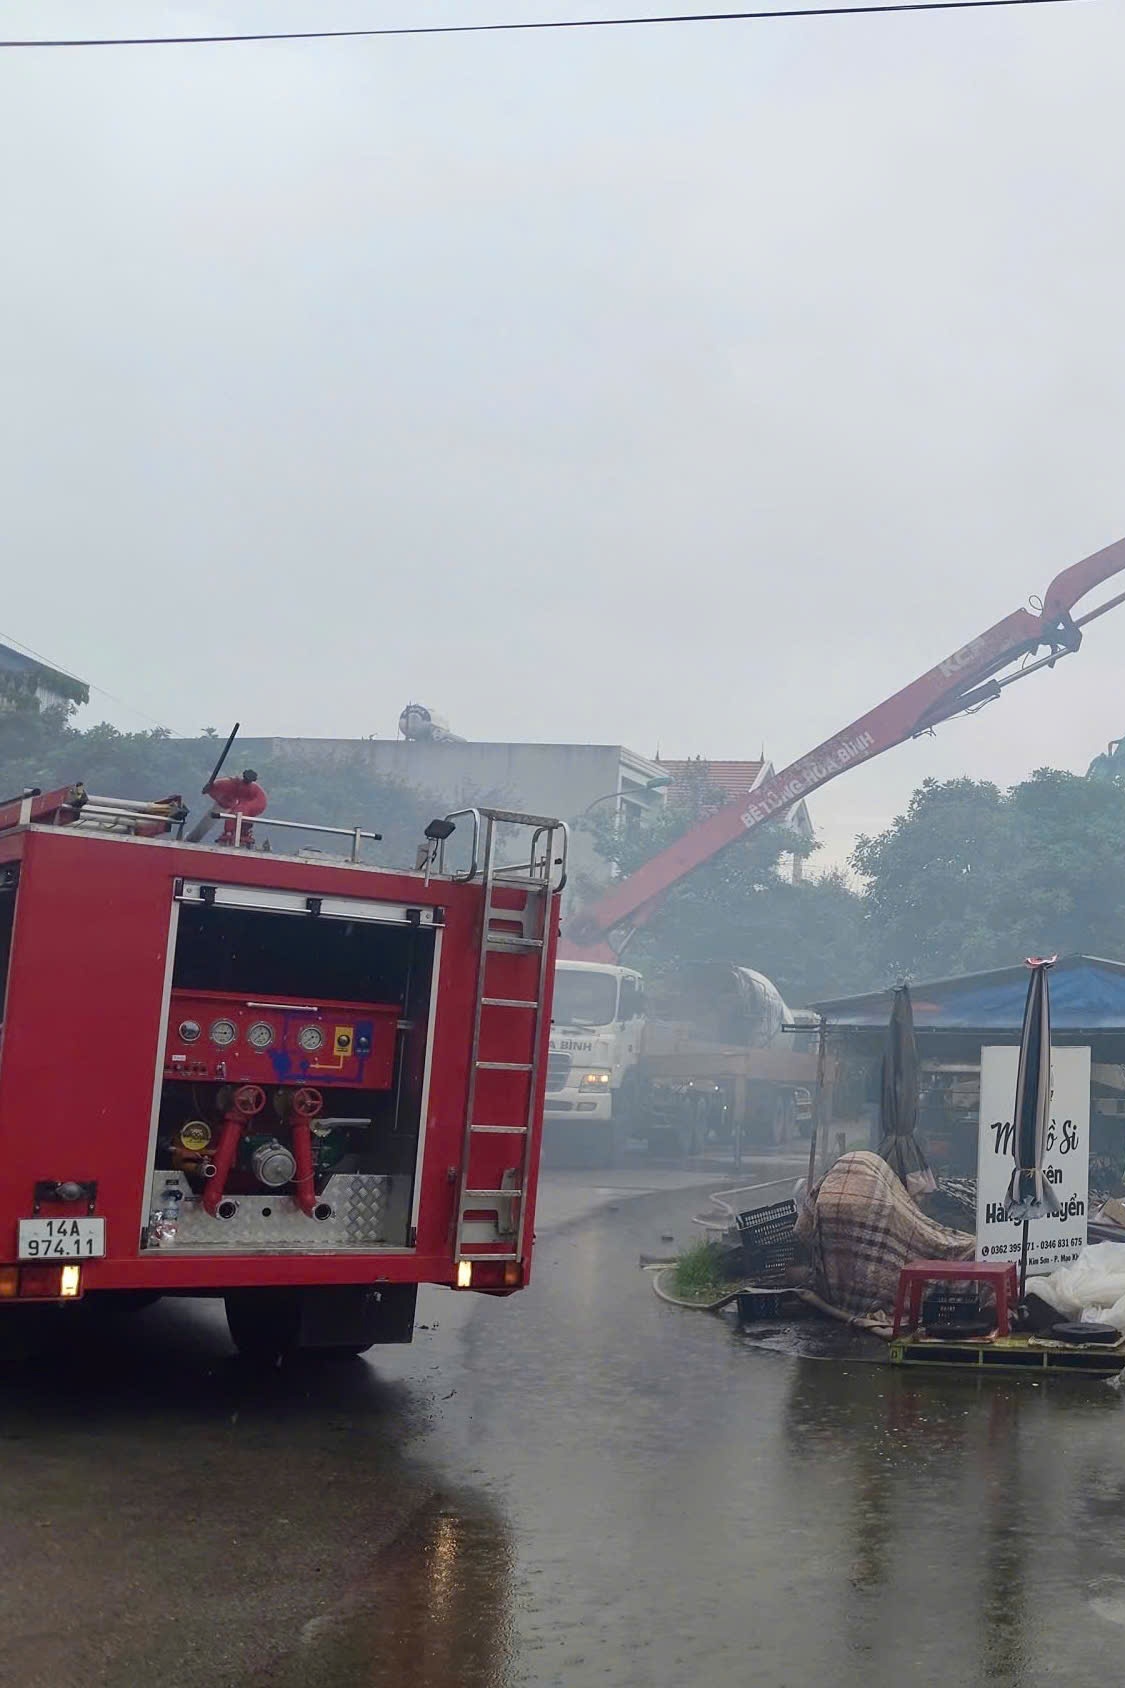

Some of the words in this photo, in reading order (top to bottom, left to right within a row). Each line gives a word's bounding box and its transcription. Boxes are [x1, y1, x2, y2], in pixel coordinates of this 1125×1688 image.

[560, 1039, 592, 1052] BÌNH
[1060, 1119, 1079, 1154] Si
[46, 1220, 80, 1237] 14A
[28, 1239, 94, 1256] 974.11
[990, 1245, 1007, 1255] 0362
[1009, 1243, 1021, 1253] 395
[1040, 1240, 1056, 1250] 0346
[1057, 1238, 1069, 1247] 831
[1070, 1237, 1082, 1246] 675
